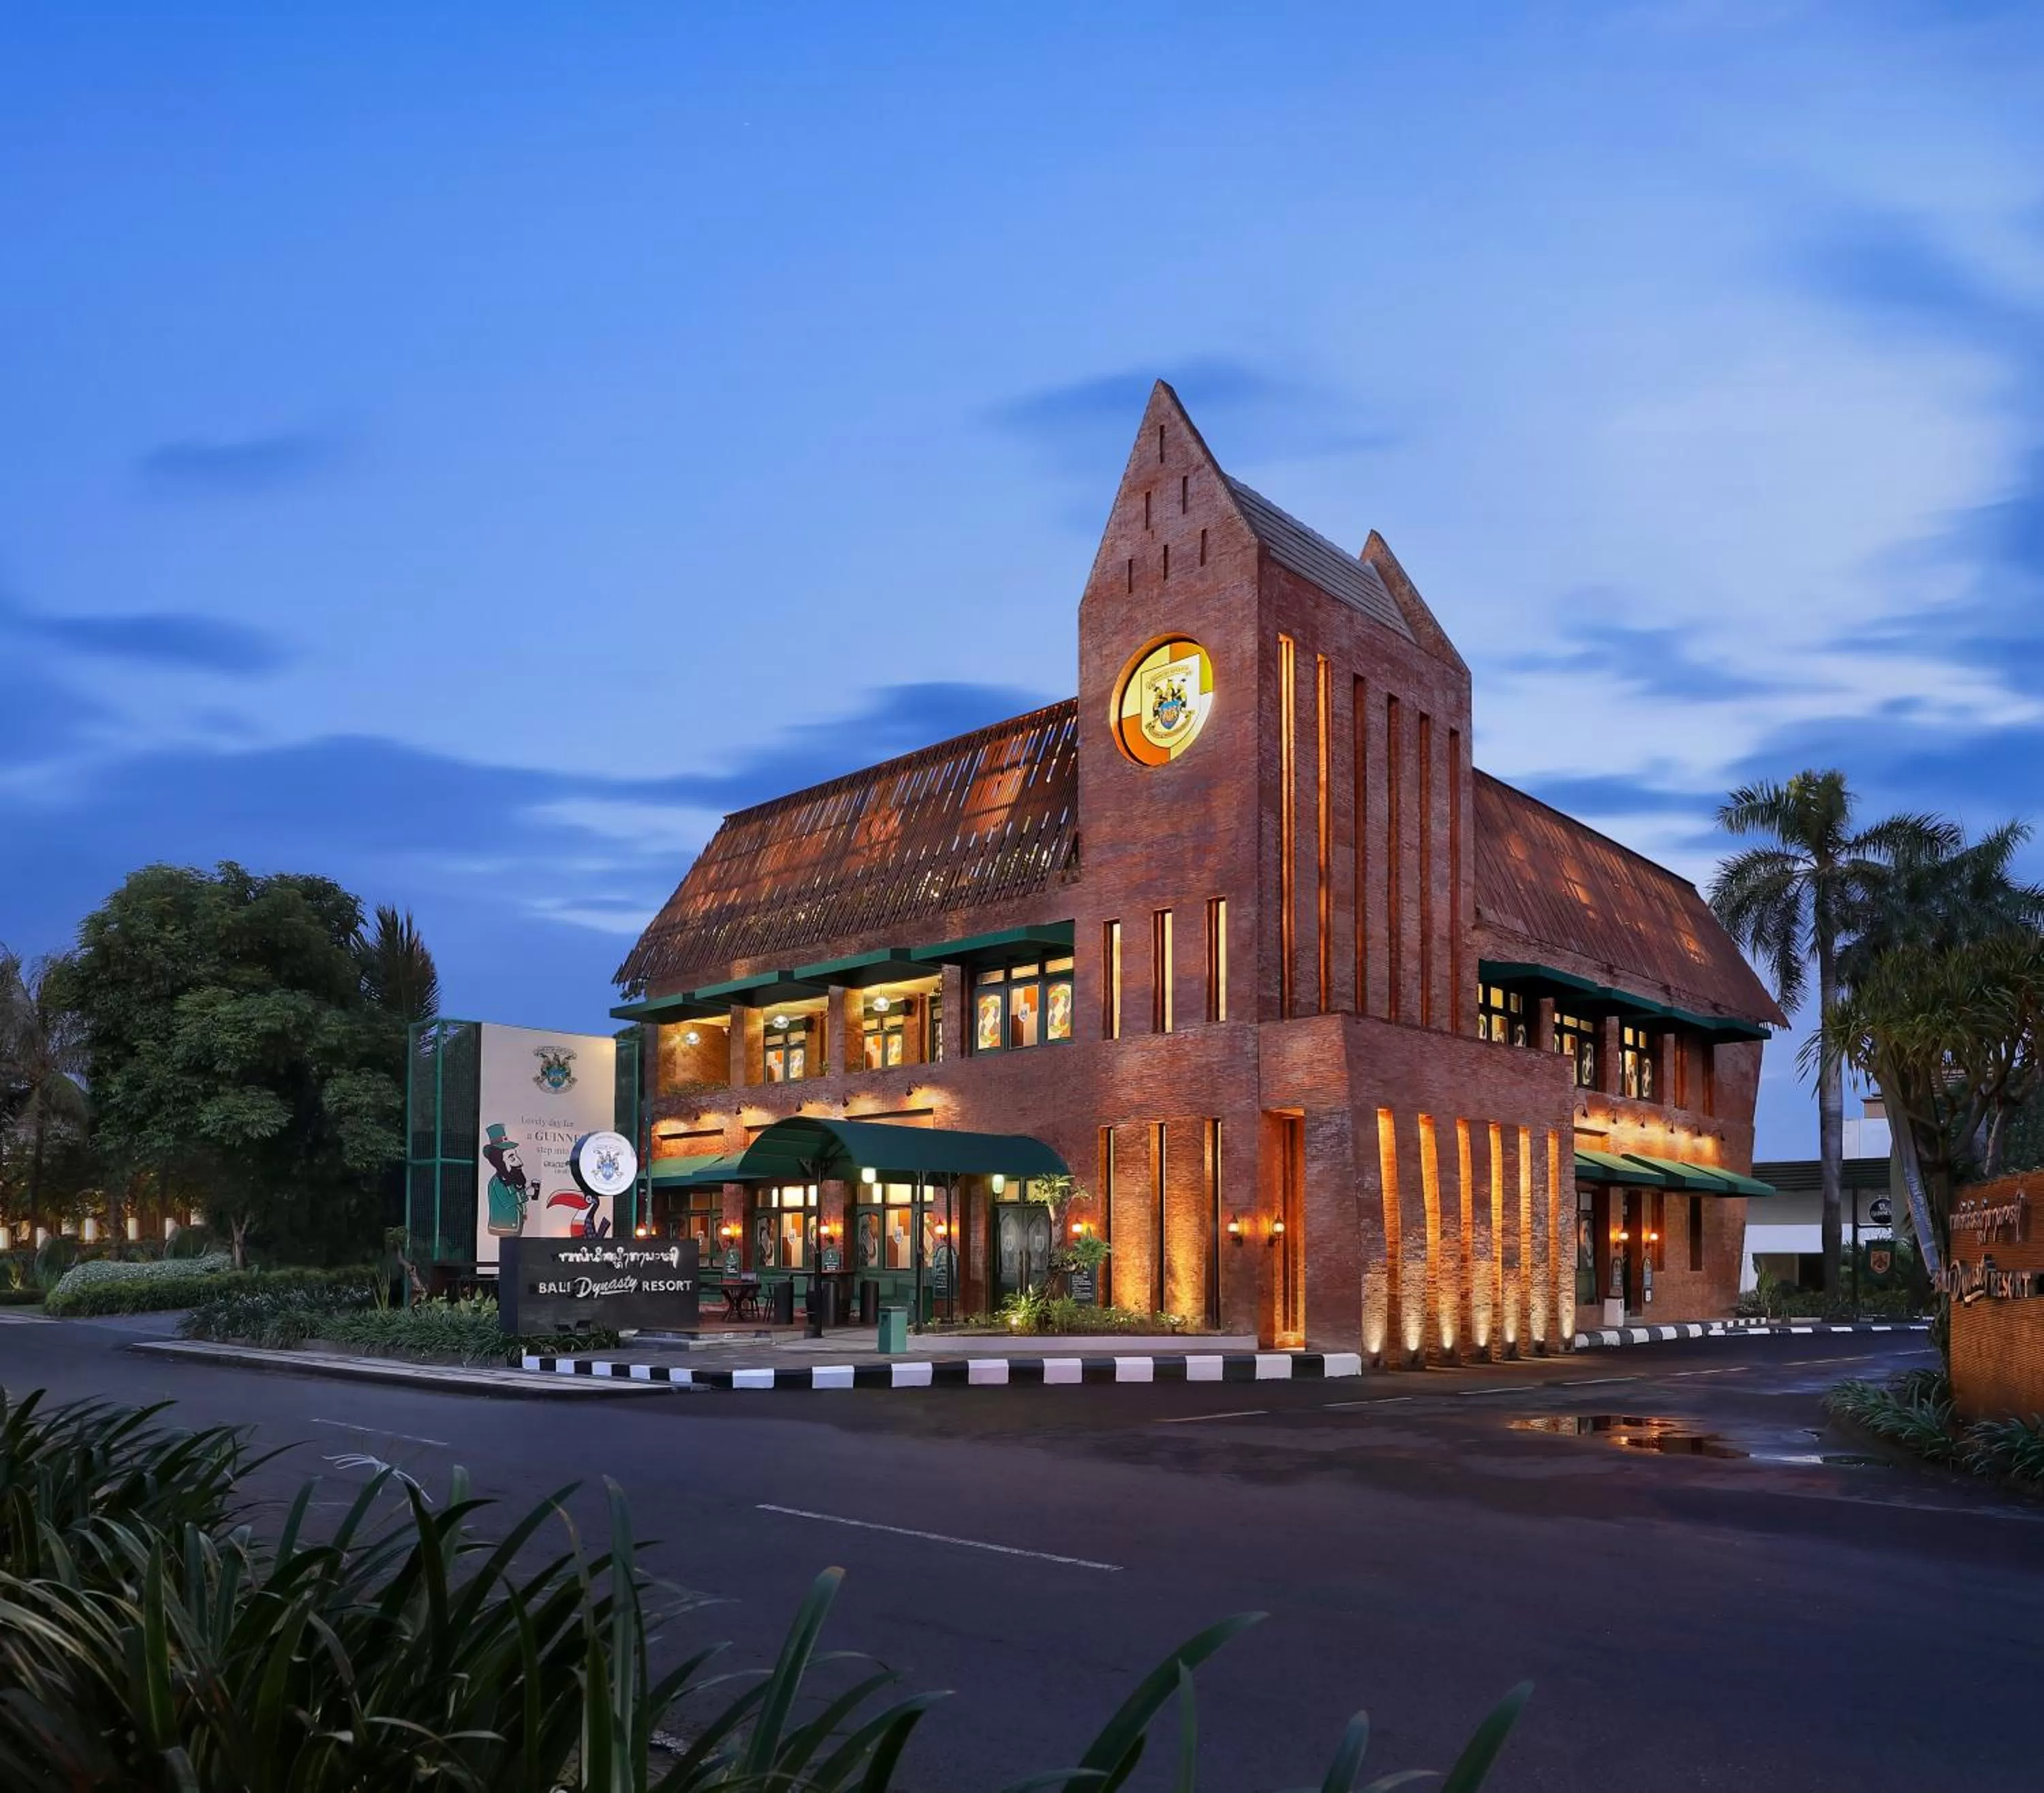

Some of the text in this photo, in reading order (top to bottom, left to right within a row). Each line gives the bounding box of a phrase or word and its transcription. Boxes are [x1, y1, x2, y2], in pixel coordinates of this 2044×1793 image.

[538, 1275, 693, 1298] BALI Dynasty RESORT
